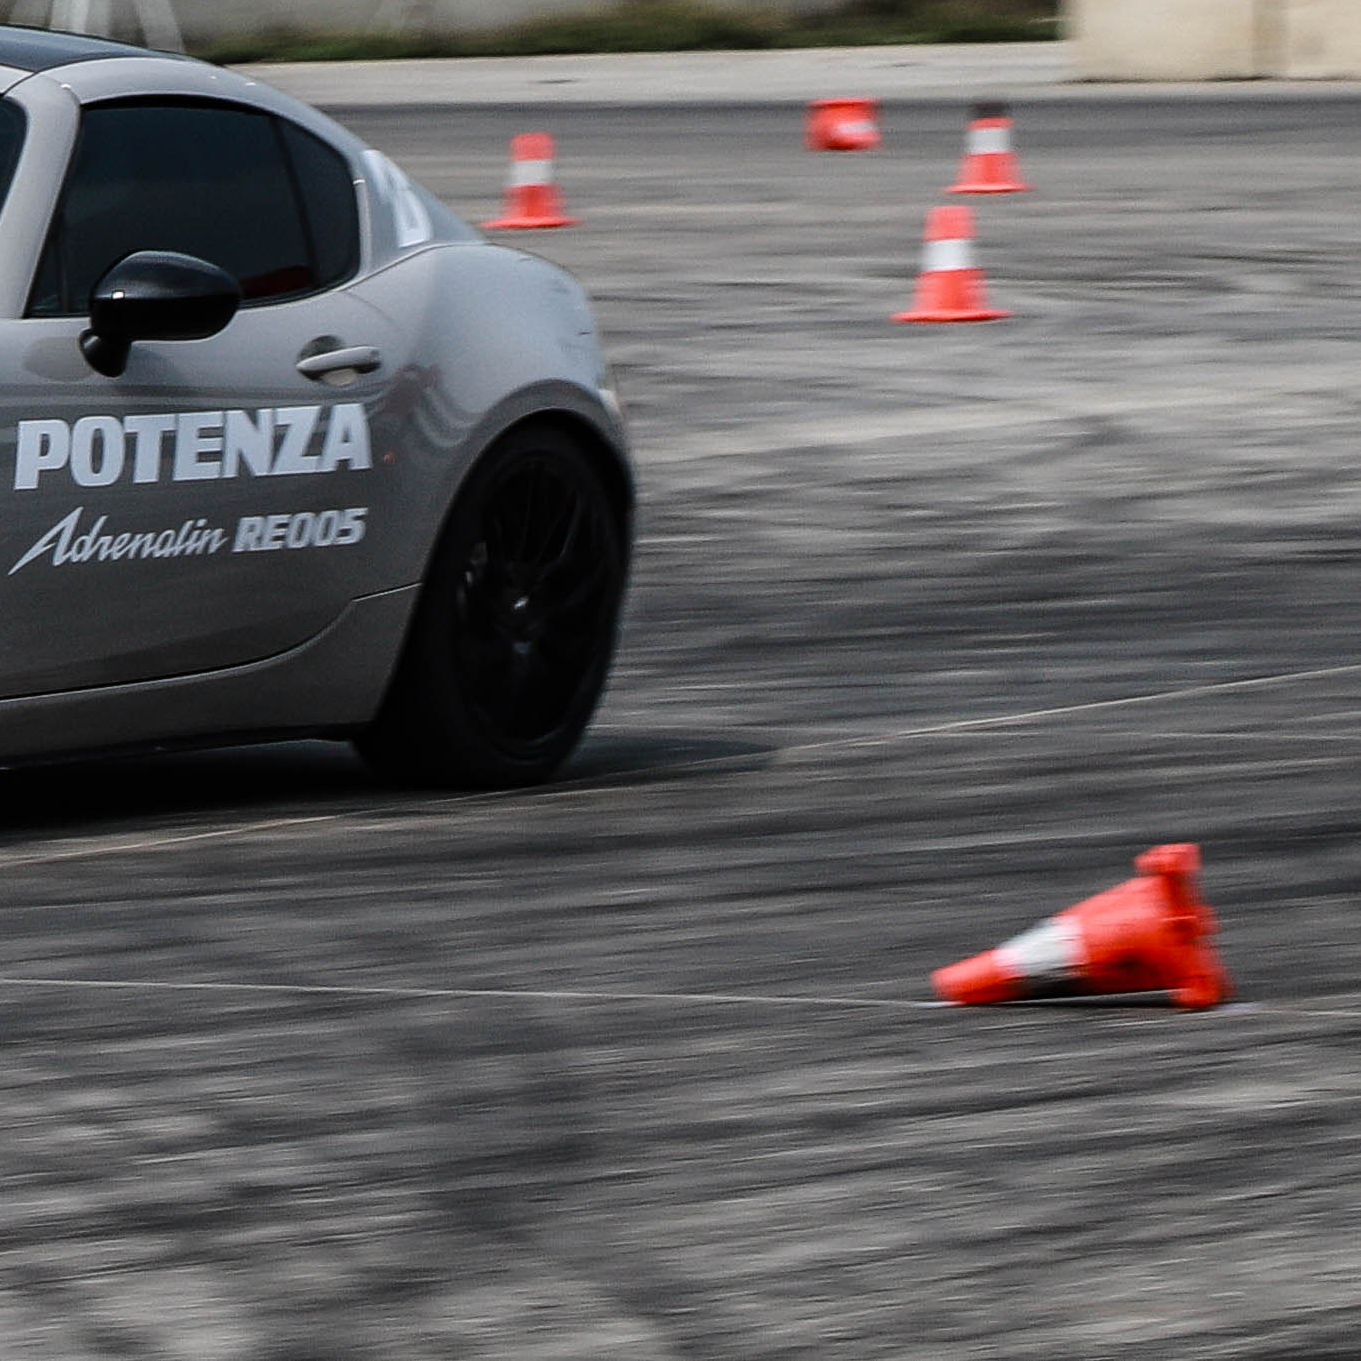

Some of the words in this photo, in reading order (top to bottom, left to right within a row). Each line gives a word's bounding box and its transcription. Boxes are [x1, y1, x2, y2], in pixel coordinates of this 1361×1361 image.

[13, 403, 372, 491] POTENZA
[8, 506, 228, 575] Adrenalin
[232, 507, 369, 553] RE005
